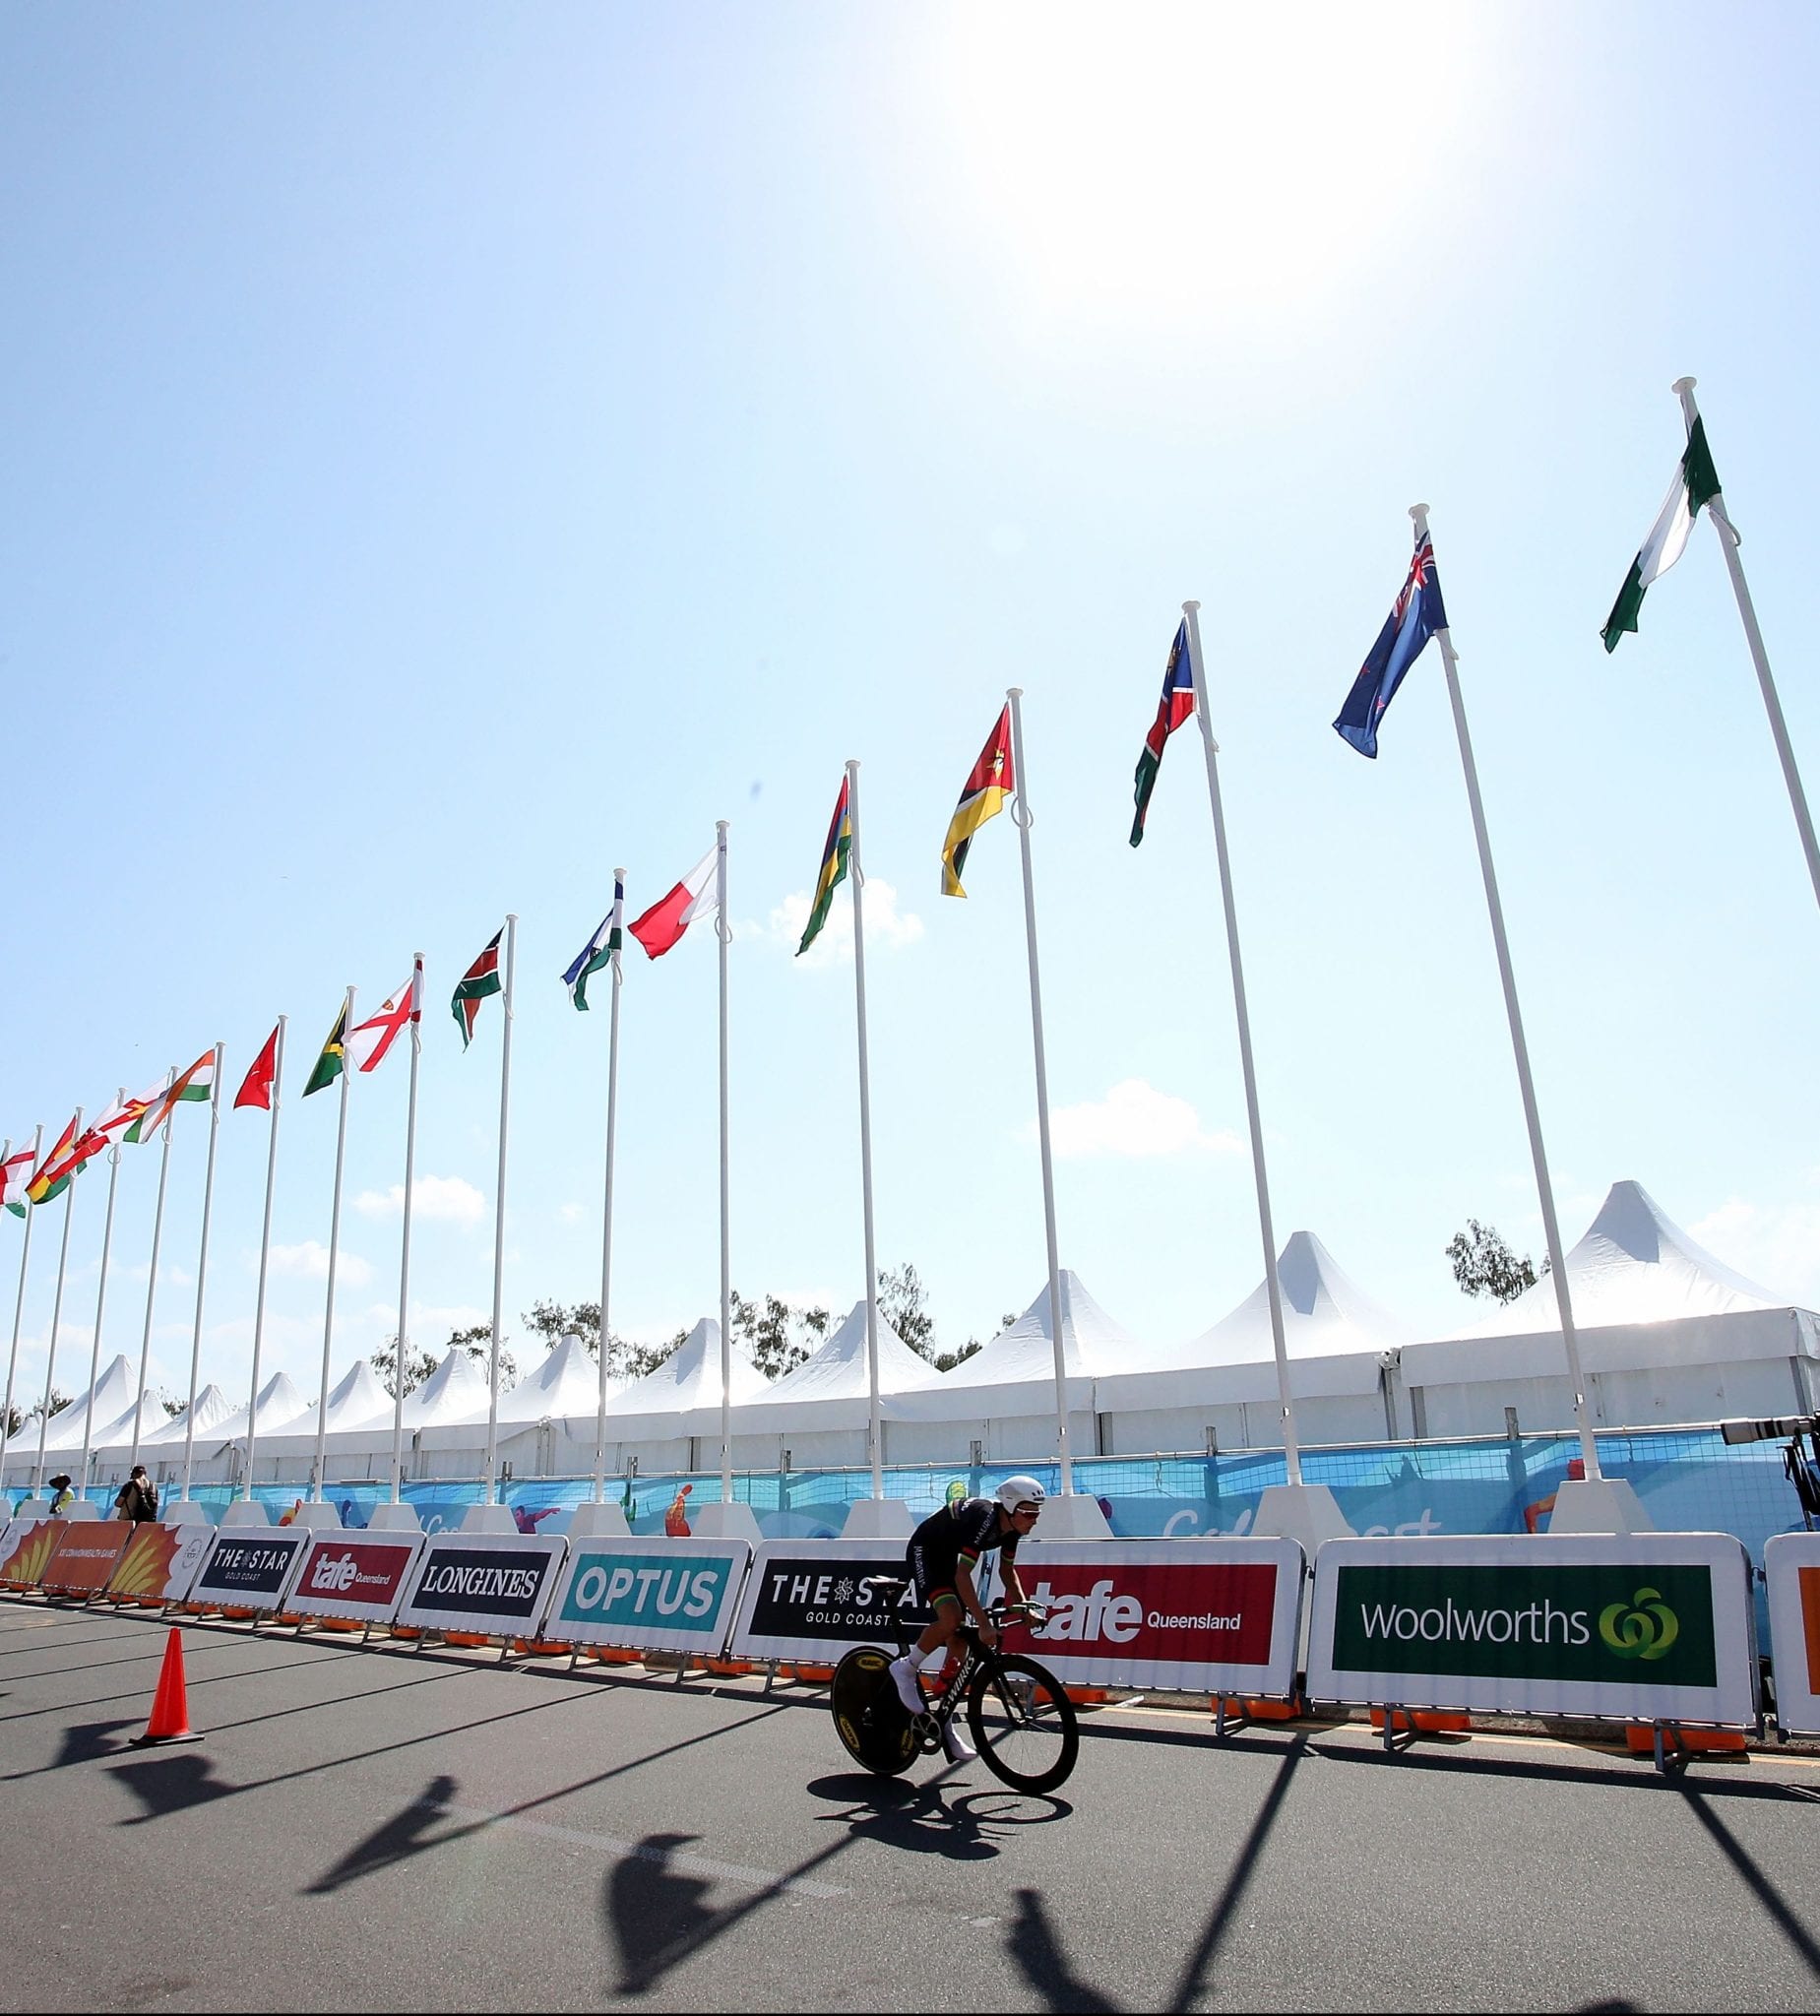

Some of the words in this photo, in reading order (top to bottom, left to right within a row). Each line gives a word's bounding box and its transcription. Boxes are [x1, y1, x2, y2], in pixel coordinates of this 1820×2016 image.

[214, 1548, 244, 1568] THE
[248, 1549, 288, 1570] STAR
[224, 1571, 241, 1580] GOLD
[240, 1572, 261, 1582] COAST
[311, 1552, 357, 1591] tafe
[355, 1572, 391, 1585] Queensland
[421, 1565, 539, 1600] LONGINES
[575, 1566, 719, 1617] OPTUS
[772, 1574, 833, 1605] THE
[855, 1576, 931, 1608] SA
[805, 1610, 841, 1624] GOLD
[846, 1612, 891, 1626] COAST
[1030, 1579, 1143, 1644] tafe
[1147, 1610, 1242, 1630] Queensland
[1360, 1597, 1591, 1645] Woolworths
[942, 1656, 975, 1716] S-WORKS
